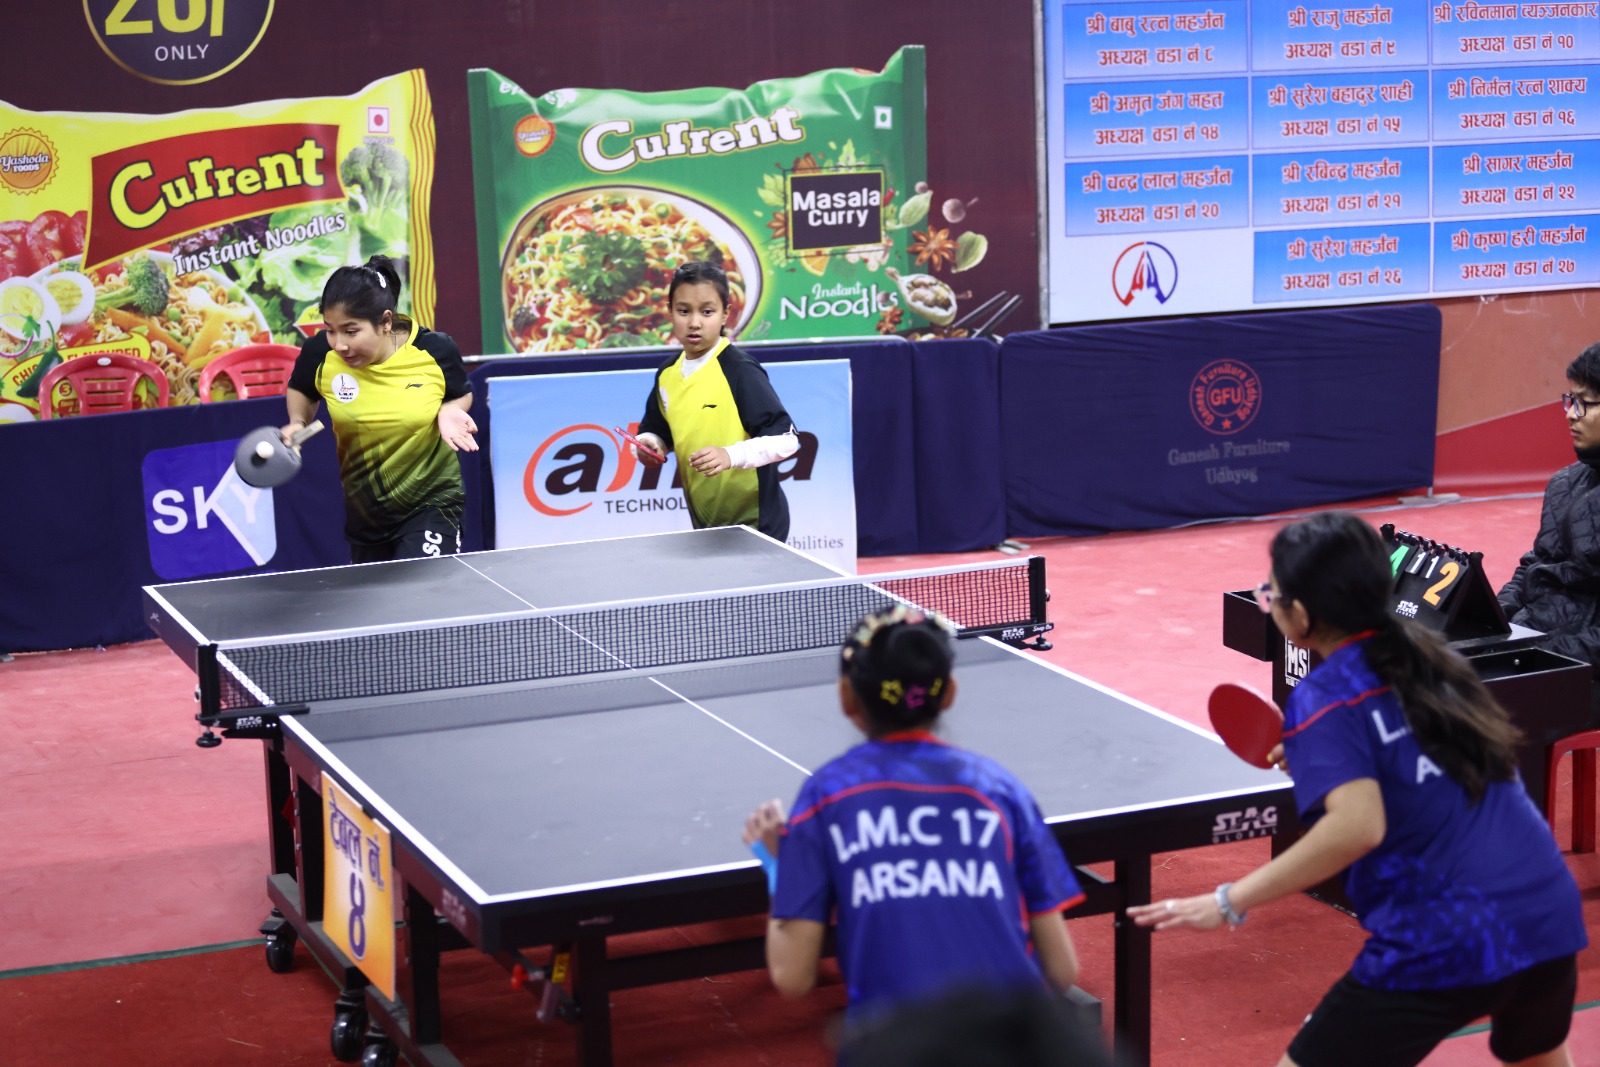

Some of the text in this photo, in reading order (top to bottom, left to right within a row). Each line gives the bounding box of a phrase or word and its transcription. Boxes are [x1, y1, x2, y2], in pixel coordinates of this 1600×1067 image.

[1087, 10, 1224, 36] श्री बाबु रत्न महर्जन
[1289, 5, 1392, 29] श्री राजु महर्जन
[1434, 2, 1452, 22] श्री
[154, 44, 209, 61] ONLY
[1340, 41, 1366, 57] वडा
[1513, 35, 1537, 51] वडा
[1156, 48, 1182, 64] वडा
[1269, 80, 1413, 108] श्री सुरेश बहादुर शाही
[1449, 78, 1466, 99] श्री
[1470, 77, 1512, 96] निर्मल
[1516, 79, 1544, 95] रत्न
[1091, 92, 1110, 113] श्री
[1115, 95, 1153, 115] अमृत
[1336, 118, 1362, 134] वडा
[1513, 111, 1538, 126] वडा
[581, 106, 804, 172] Current
[1152, 127, 1178, 142] वडा
[0, 153, 50, 172] Yashoda
[1283, 162, 1301, 182] श्री
[1352, 159, 1401, 179] महर्जन
[1464, 151, 1573, 174] श्री सागर महर्जन
[110, 139, 324, 229] Current
[1083, 171, 1102, 193] श्री
[1143, 172, 1177, 189] लाल
[1182, 167, 1232, 188] महर्जन
[792, 187, 881, 211] Masala
[1337, 195, 1362, 211] वडा
[1514, 186, 1538, 202] वडा
[808, 208, 869, 228] Curry
[1153, 205, 1179, 221] वडा
[174, 213, 346, 276] Instant Noodles
[1288, 235, 1398, 261] श्री सुरेश महर्जन
[1452, 229, 1470, 250] श्री
[1473, 231, 1508, 252] कृष्ण
[1540, 225, 1586, 245] महर्जन
[1338, 271, 1363, 287] वडा
[1513, 261, 1538, 276] वडा
[811, 281, 862, 300] Instant
[61, 384, 72, 397] 3
[1210, 387, 1241, 406] GFU
[152, 462, 266, 566] SKY
[604, 497, 689, 515] TECHNOL
[1410, 551, 1427, 574] 1
[1425, 555, 1440, 579] 1
[1422, 561, 1460, 607] 2
[1212, 805, 1278, 832] STAG
[829, 805, 1000, 863] L.M.C 17
[1212, 828, 1278, 844] GLOBAL
[851, 859, 1005, 908] ARSANA
